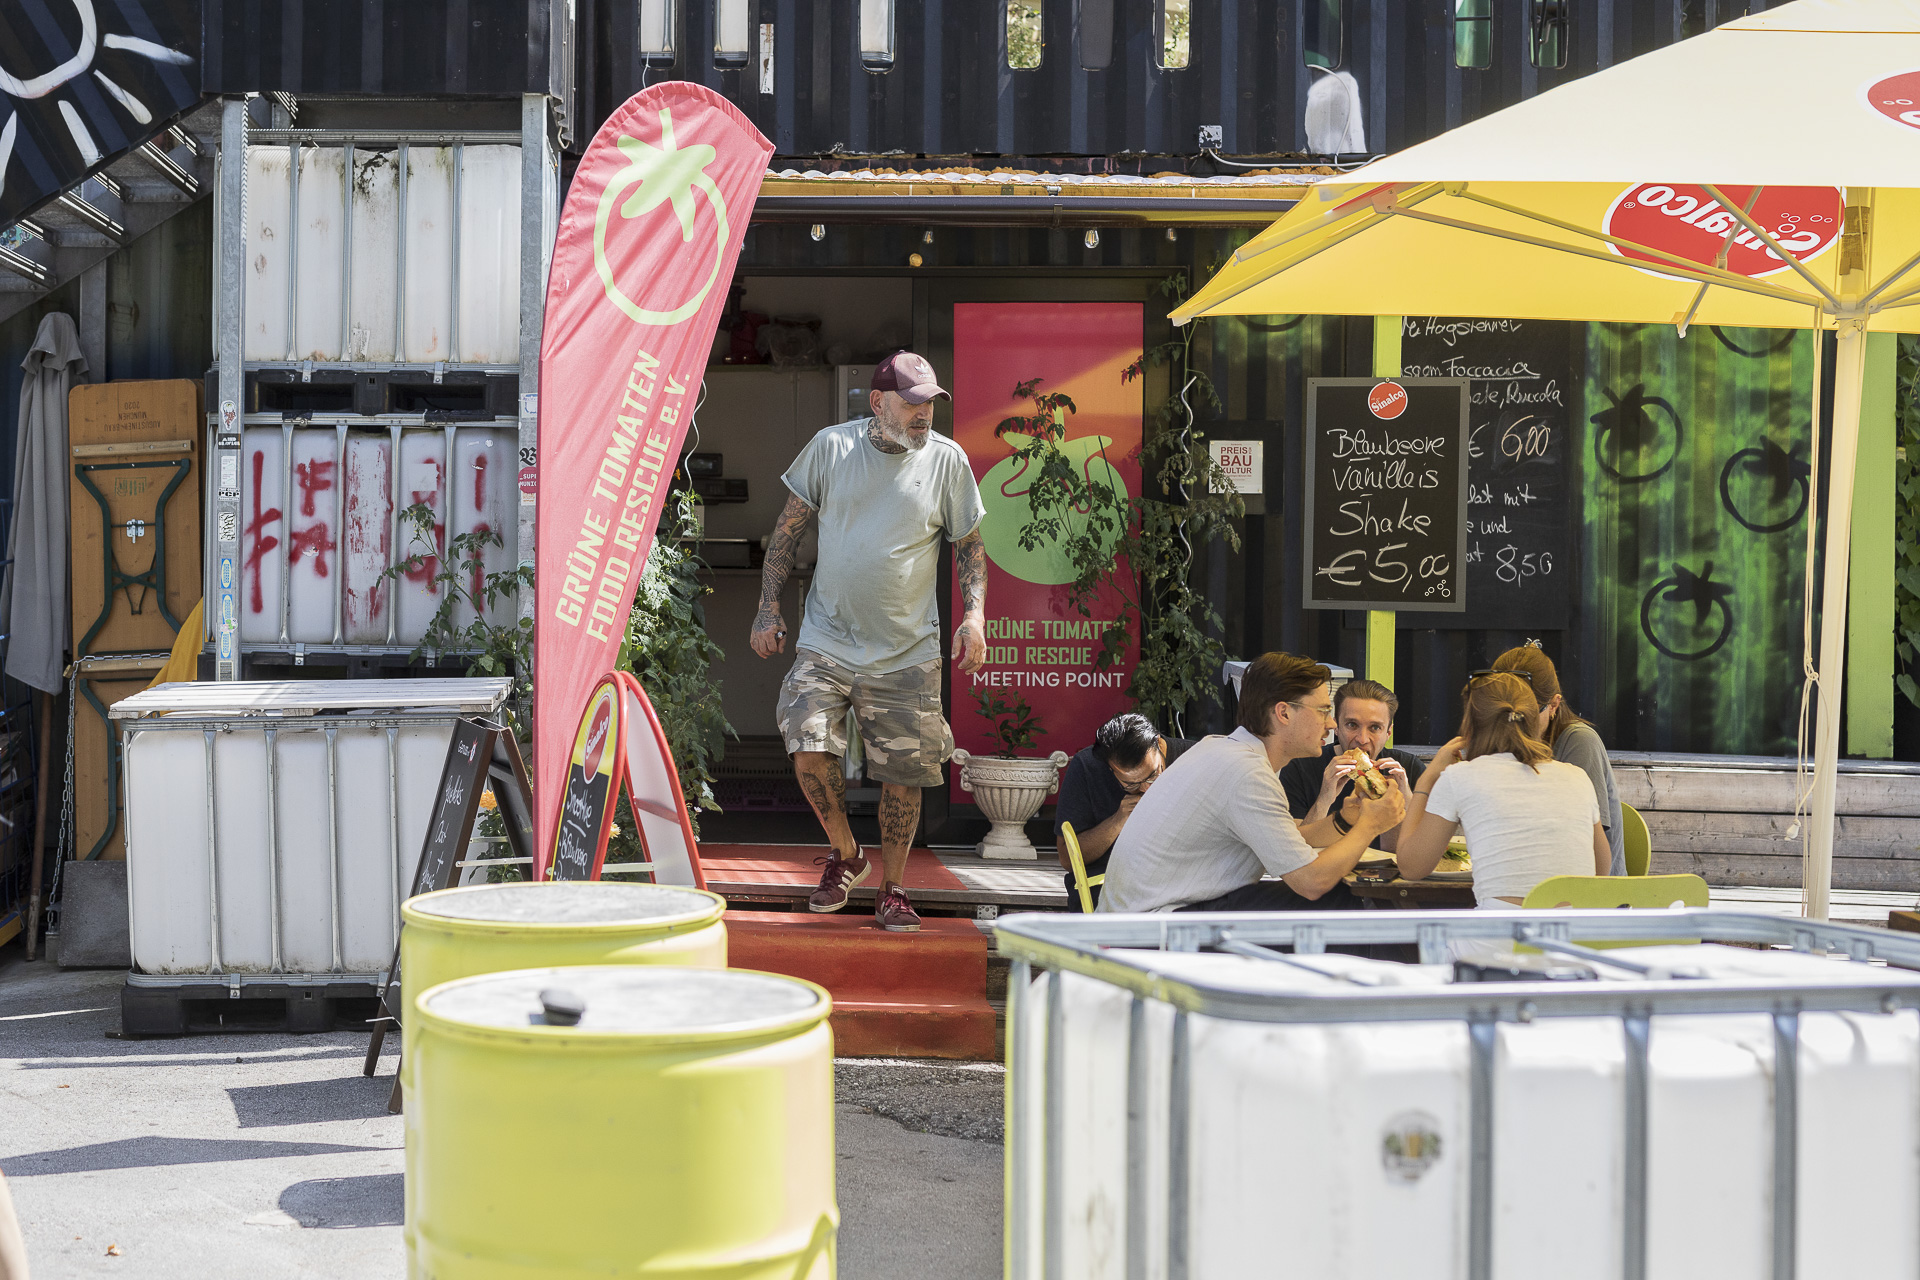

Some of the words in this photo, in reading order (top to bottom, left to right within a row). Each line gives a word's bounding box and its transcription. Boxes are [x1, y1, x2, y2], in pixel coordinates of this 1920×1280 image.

[1371, 389, 1406, 413] Sinalco
[1469, 382, 1505, 410] ate,
[1220, 446, 1248, 455] PREIS
[1220, 454, 1252, 467] BAU
[555, 508, 611, 628] GRÜNE
[592, 349, 661, 503] TOMATEN
[1503, 483, 1537, 506] mit
[1329, 497, 1432, 537] Shake
[1481, 515, 1513, 535] und
[586, 556, 631, 644] FOOD
[613, 428, 672, 553] RESCUE
[984, 617, 1035, 639] RÜNE
[985, 646, 1018, 664] OOD
[1025, 647, 1092, 665] RESCUE
[973, 671, 1060, 687] MEETING
[1065, 672, 1125, 688] POINT
